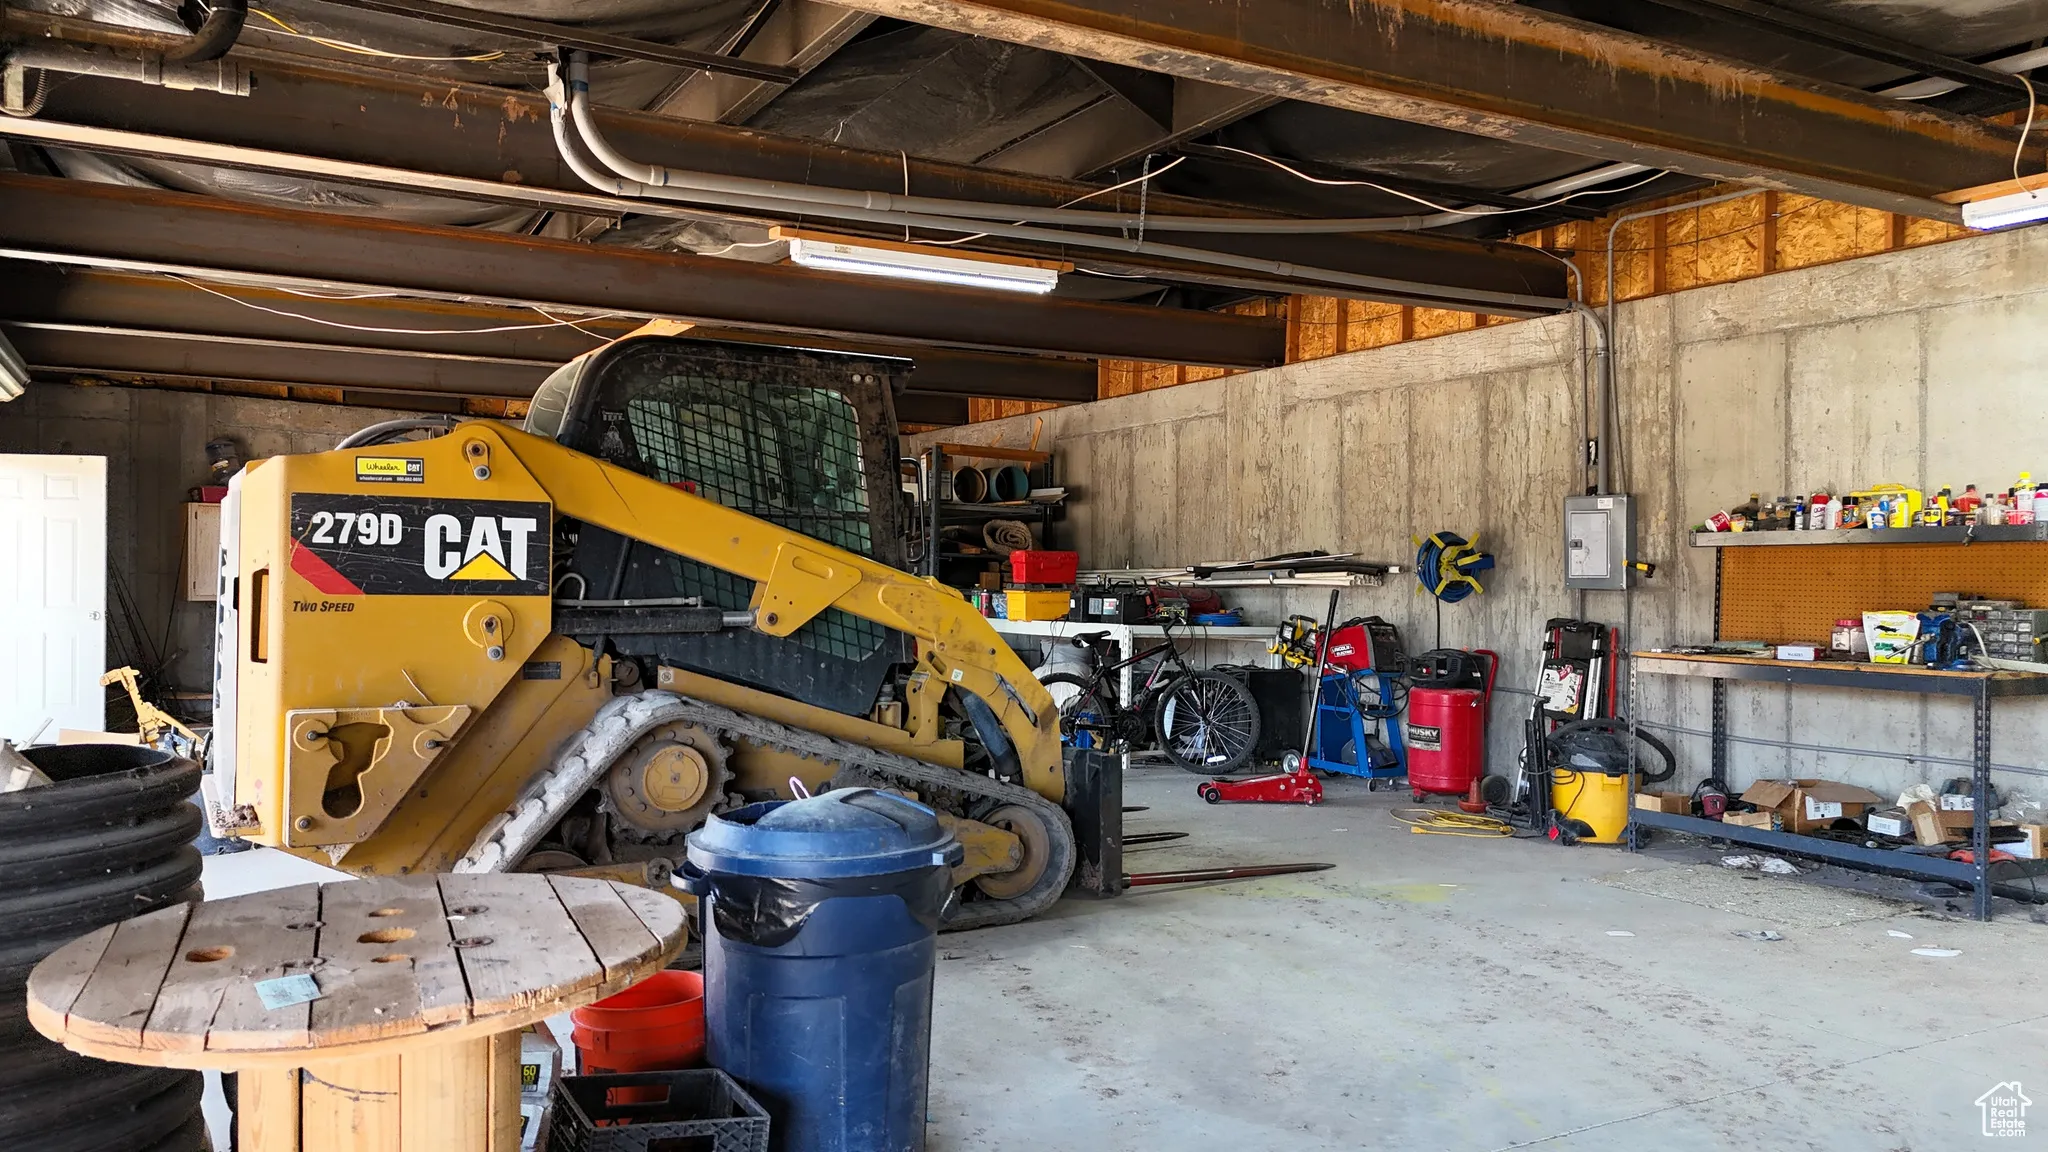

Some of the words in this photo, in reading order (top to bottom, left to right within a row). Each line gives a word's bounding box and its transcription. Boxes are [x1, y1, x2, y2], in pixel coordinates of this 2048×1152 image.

[366, 462, 400, 471] Wheeler
[407, 463, 420, 472] CAT
[311, 511, 403, 546] 279D
[424, 513, 537, 581] CAT
[293, 601, 317, 612] TWO
[320, 600, 355, 613] SPEED
[1410, 727, 1438, 737] HUSKY
[523, 1065, 536, 1076] 60
